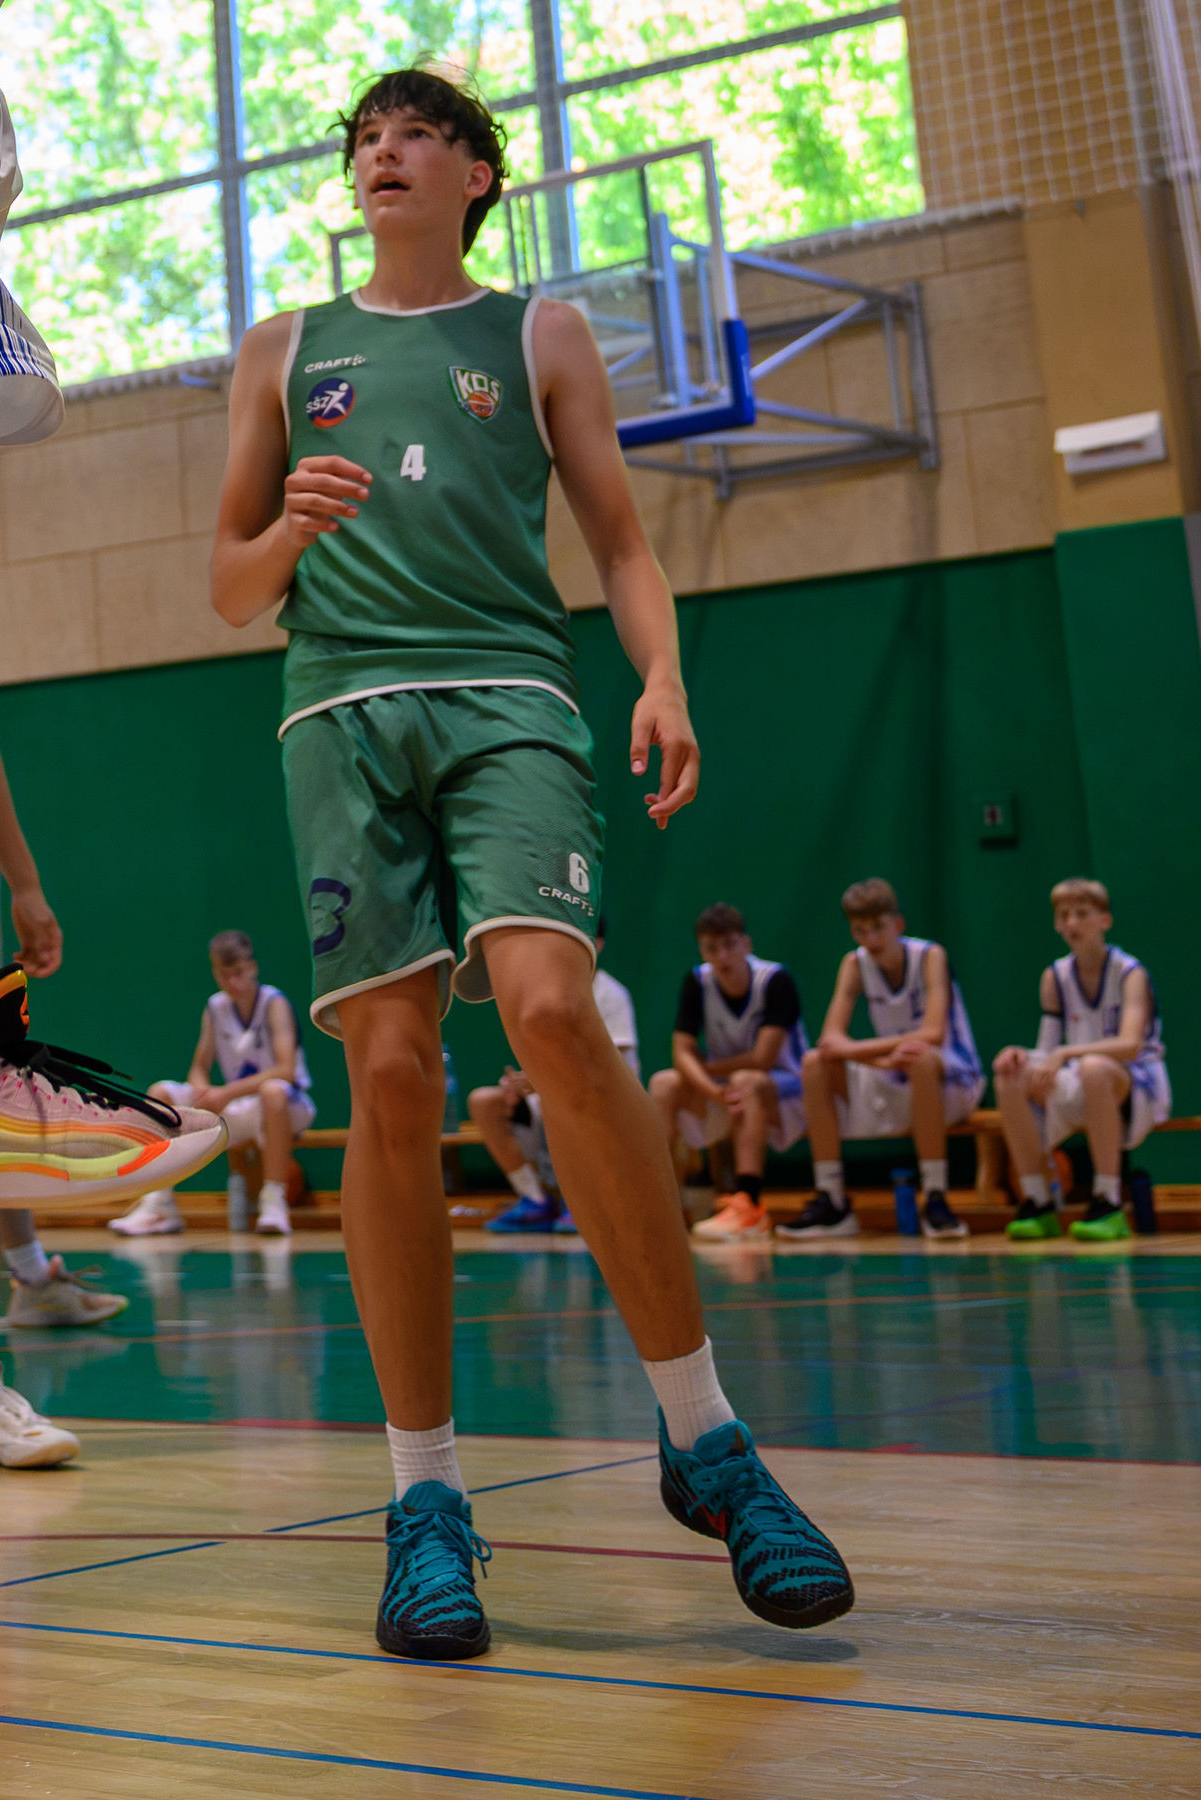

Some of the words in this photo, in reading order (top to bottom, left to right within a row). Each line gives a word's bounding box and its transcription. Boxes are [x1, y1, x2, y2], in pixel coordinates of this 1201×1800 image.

[304, 356, 353, 374] CRAFT
[455, 369, 499, 401] KOS
[400, 444, 427, 481] 4
[569, 852, 590, 894] 6
[538, 886, 589, 910] CRAFT
